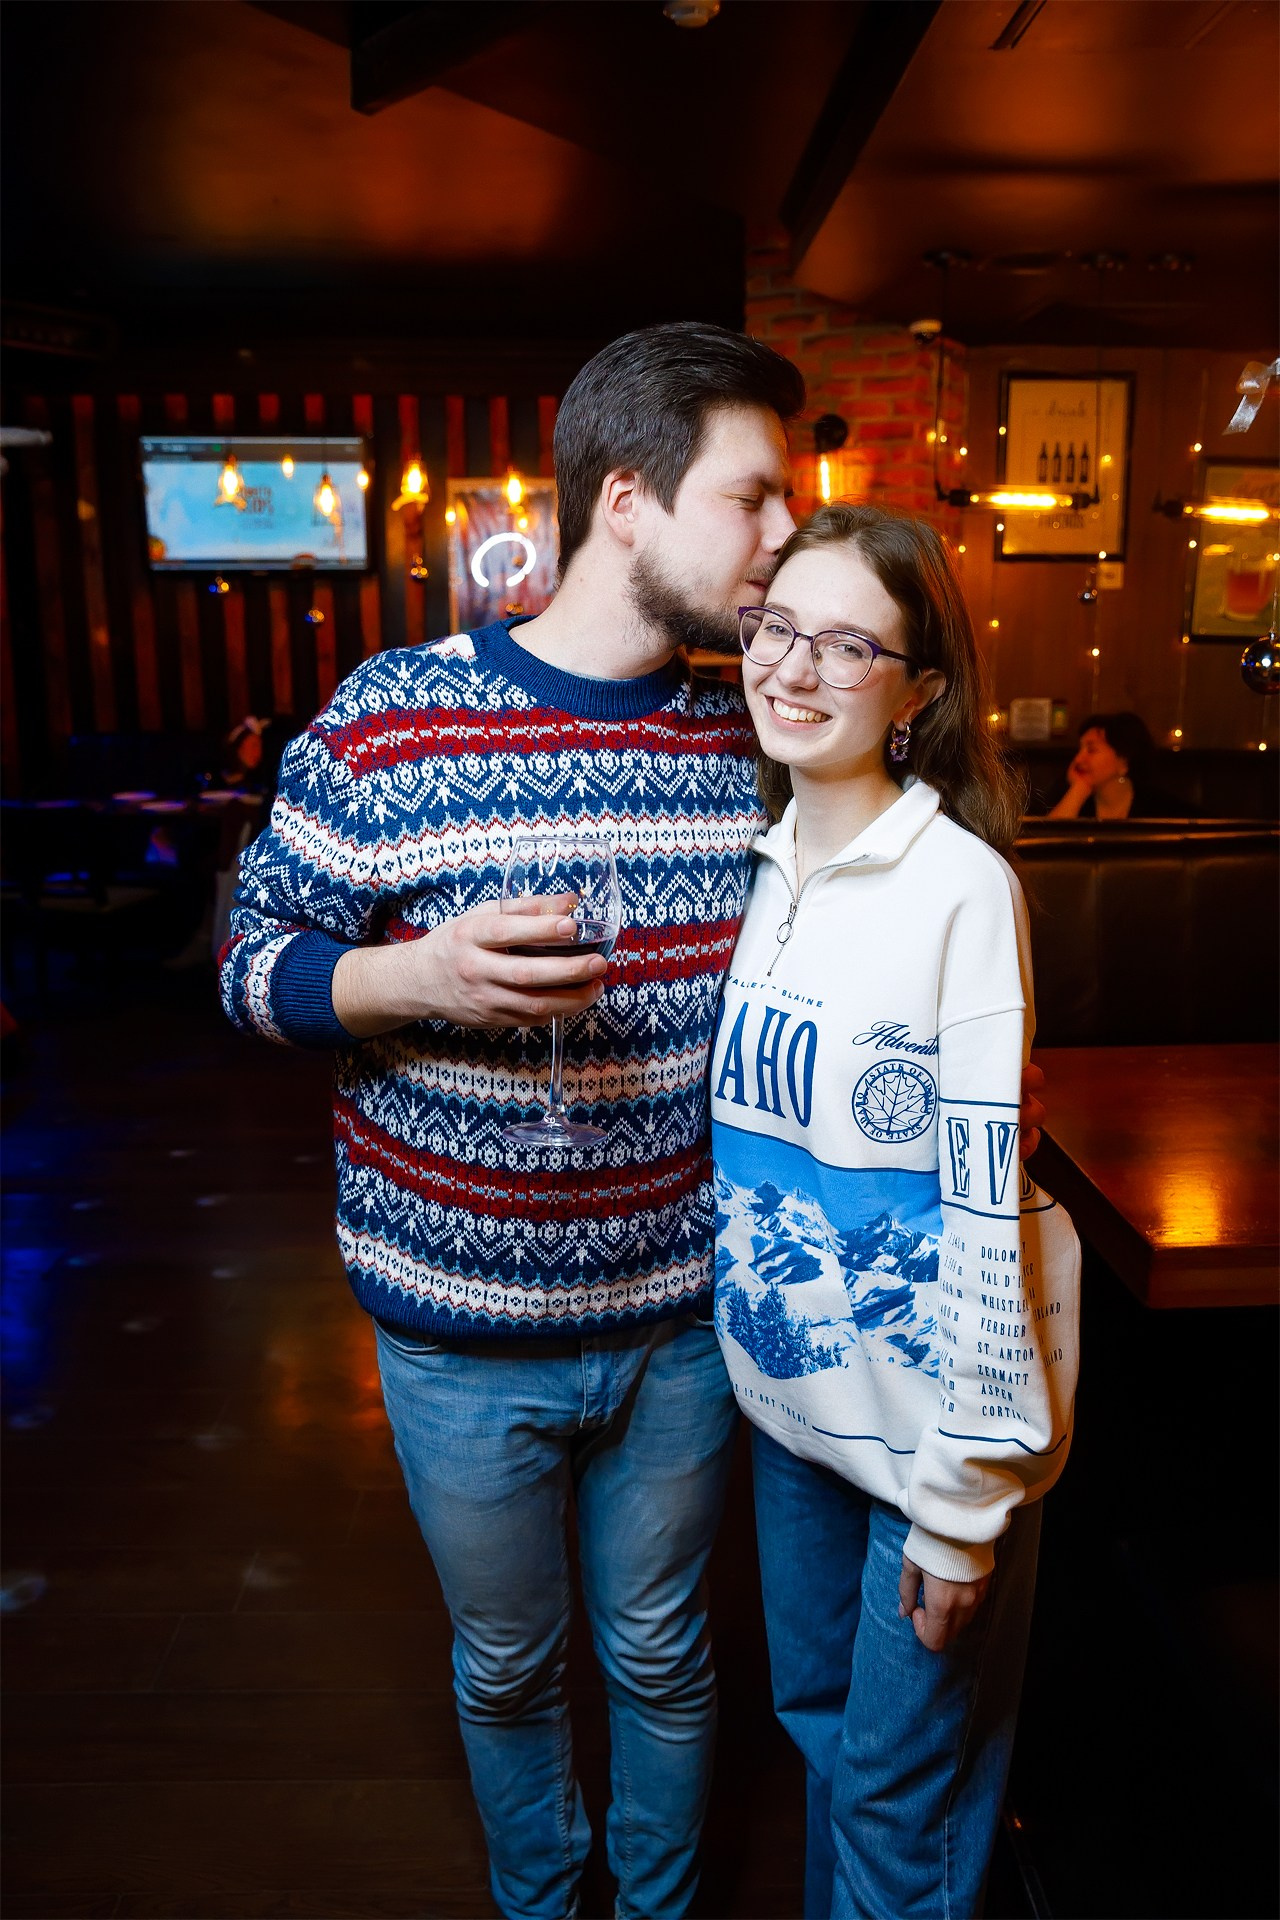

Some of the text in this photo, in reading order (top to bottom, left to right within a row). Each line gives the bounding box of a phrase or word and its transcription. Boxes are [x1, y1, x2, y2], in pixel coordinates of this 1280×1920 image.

[782, 990, 823, 1008] BLAINE
[869, 1063, 904, 1080] STATE
[981, 1270, 998, 1286] VAL
[981, 1317, 1026, 1338] VERBIER
[978, 1341, 1034, 1362] ST. ANTON
[978, 1364, 1028, 1386] ZERMATT
[981, 1383, 1013, 1402] ASPEN
